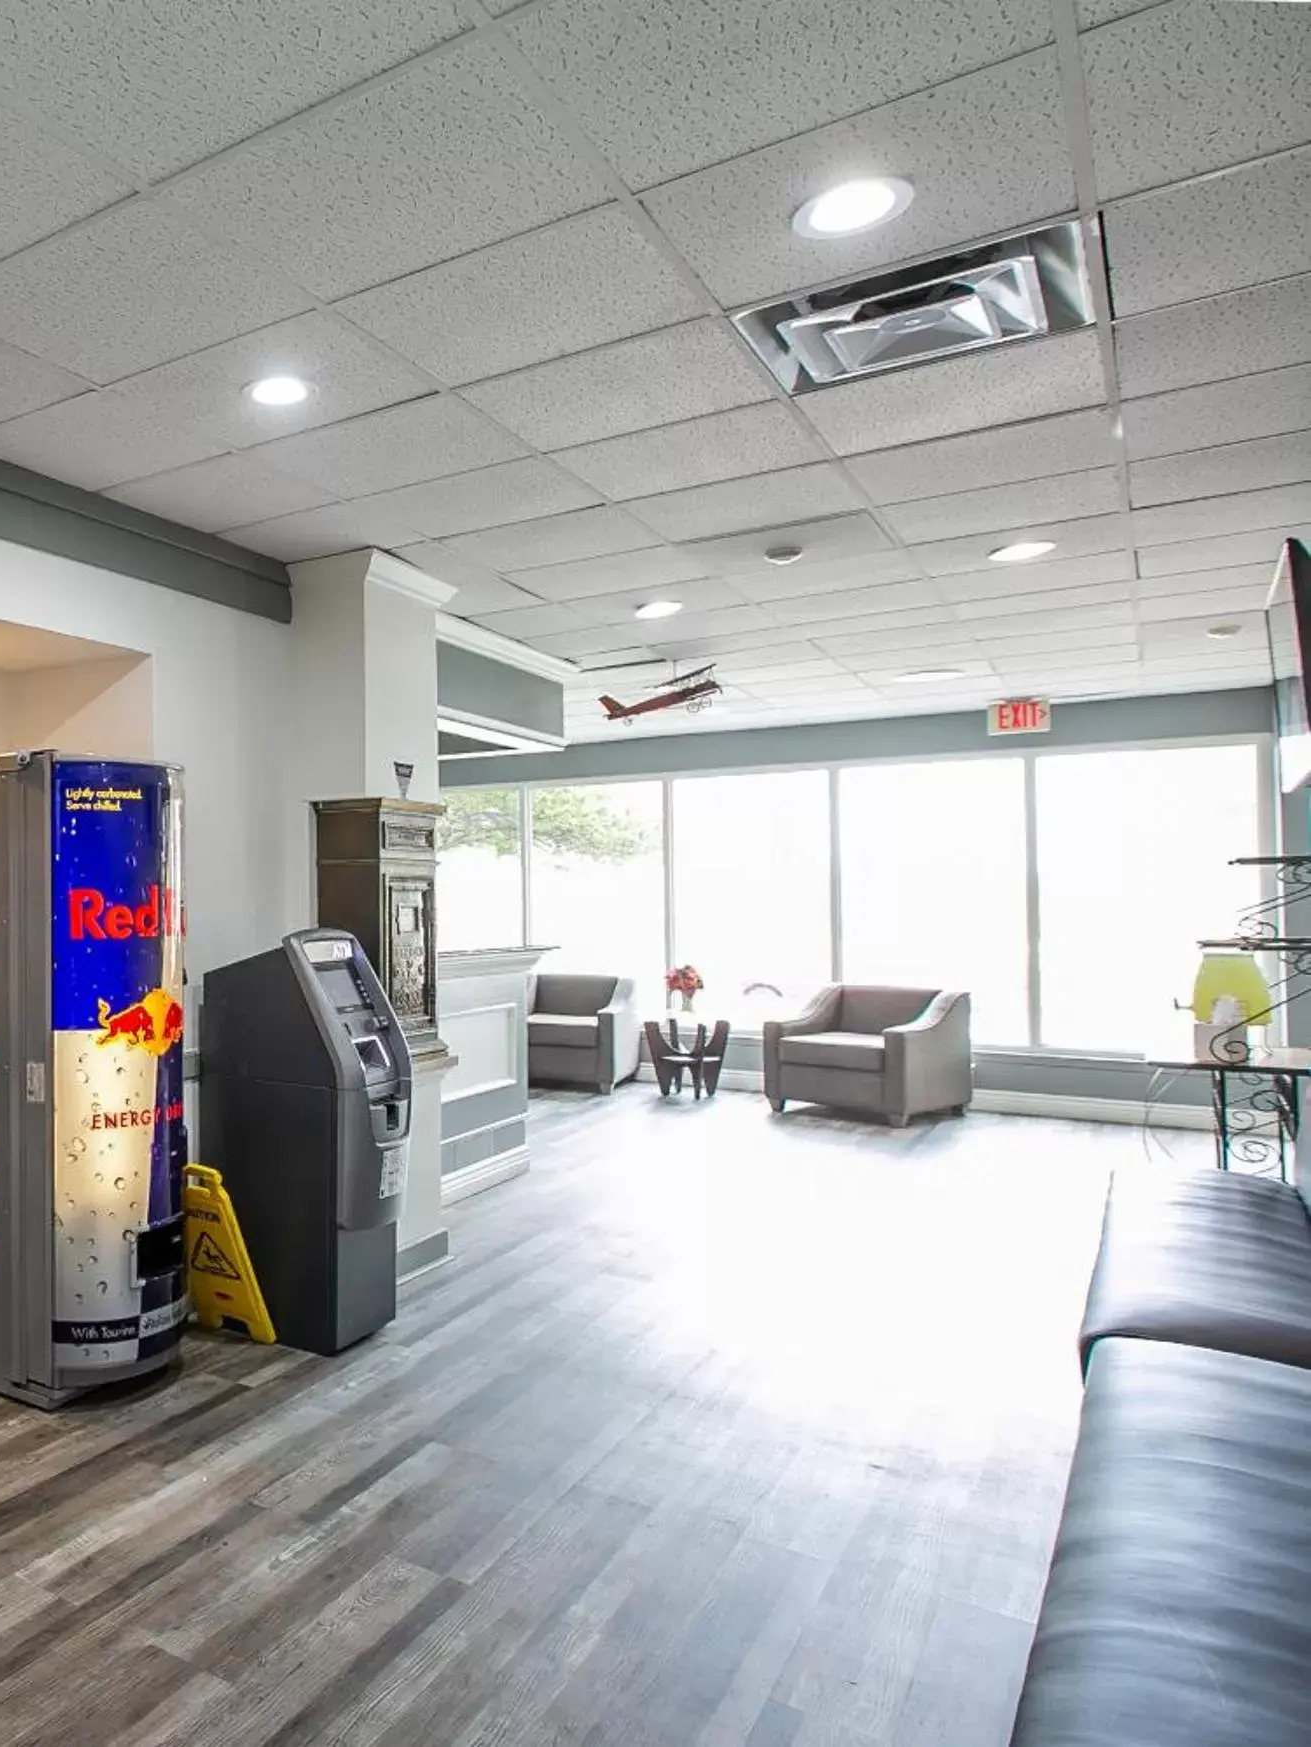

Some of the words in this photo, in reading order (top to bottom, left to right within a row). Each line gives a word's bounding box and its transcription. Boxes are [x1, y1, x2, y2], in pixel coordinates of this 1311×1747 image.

[998, 703, 1039, 729] EXIT
[69, 883, 160, 940] Red
[92, 1107, 161, 1130] ENERGY
